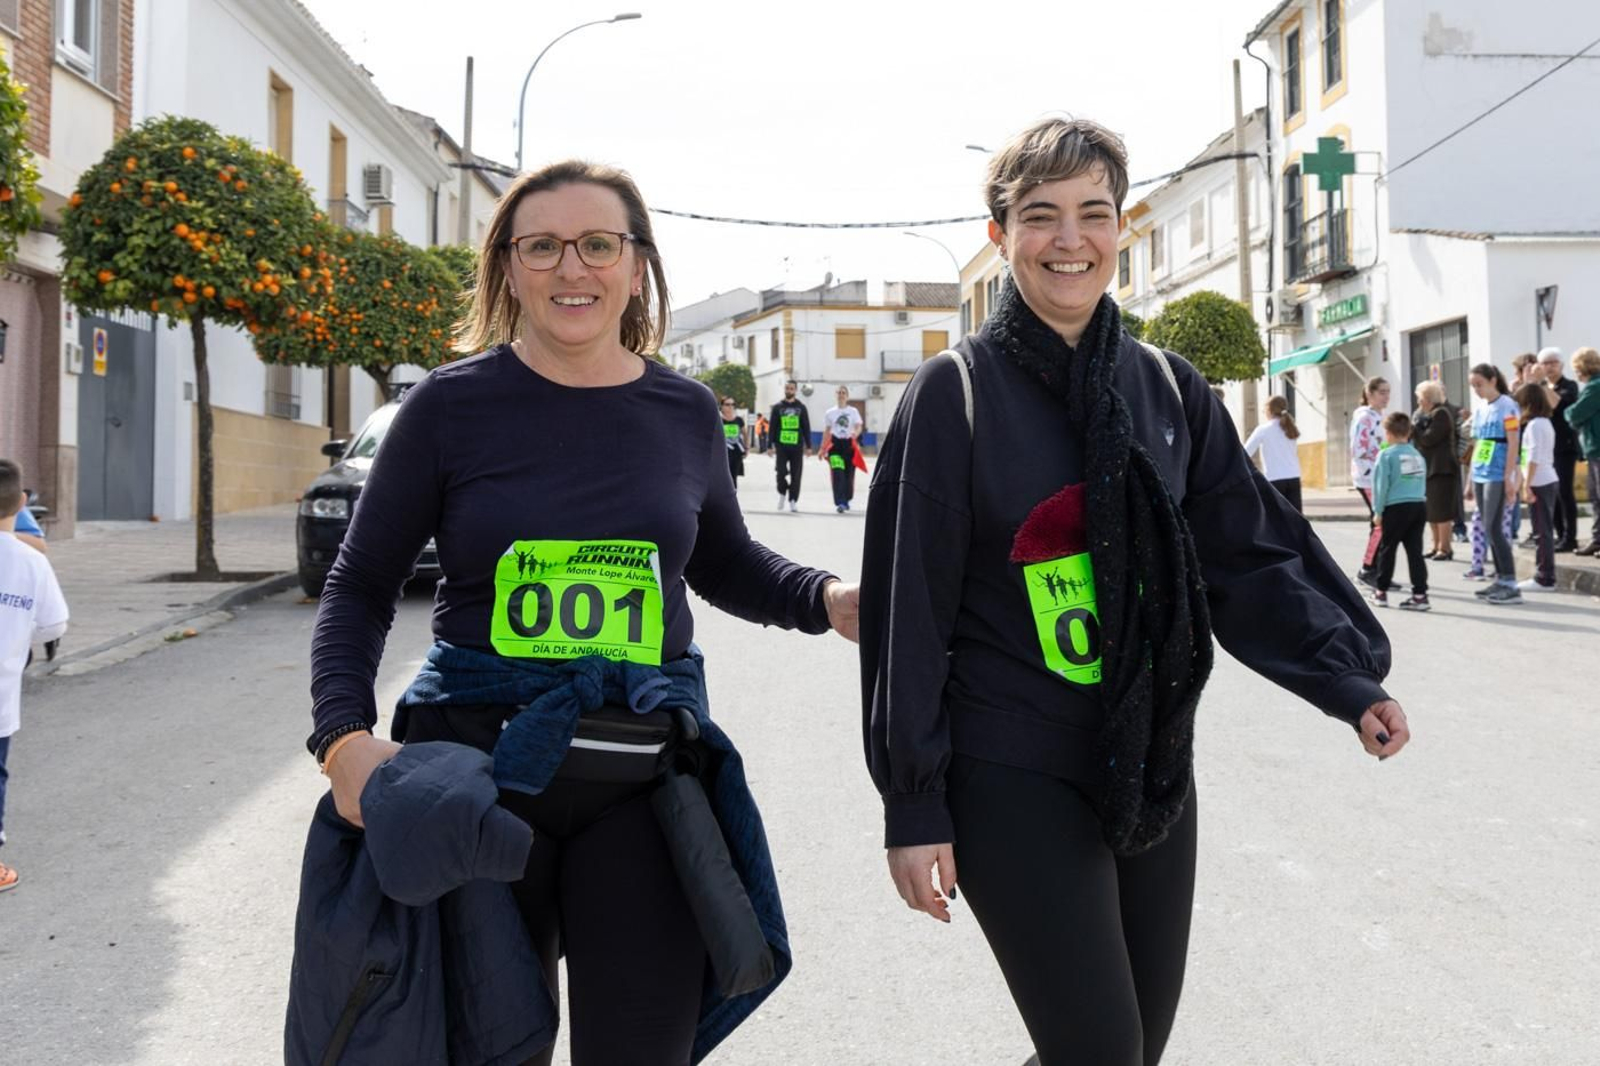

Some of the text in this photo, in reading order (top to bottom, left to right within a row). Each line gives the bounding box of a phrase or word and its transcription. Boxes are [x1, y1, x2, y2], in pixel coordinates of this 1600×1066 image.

[566, 554, 653, 570] RUNNIN
[566, 566, 597, 576] Monte
[600, 568, 623, 579] Lope
[507, 582, 645, 643] 001
[532, 643, 628, 658] DÍA DE ANDALUCÍA
